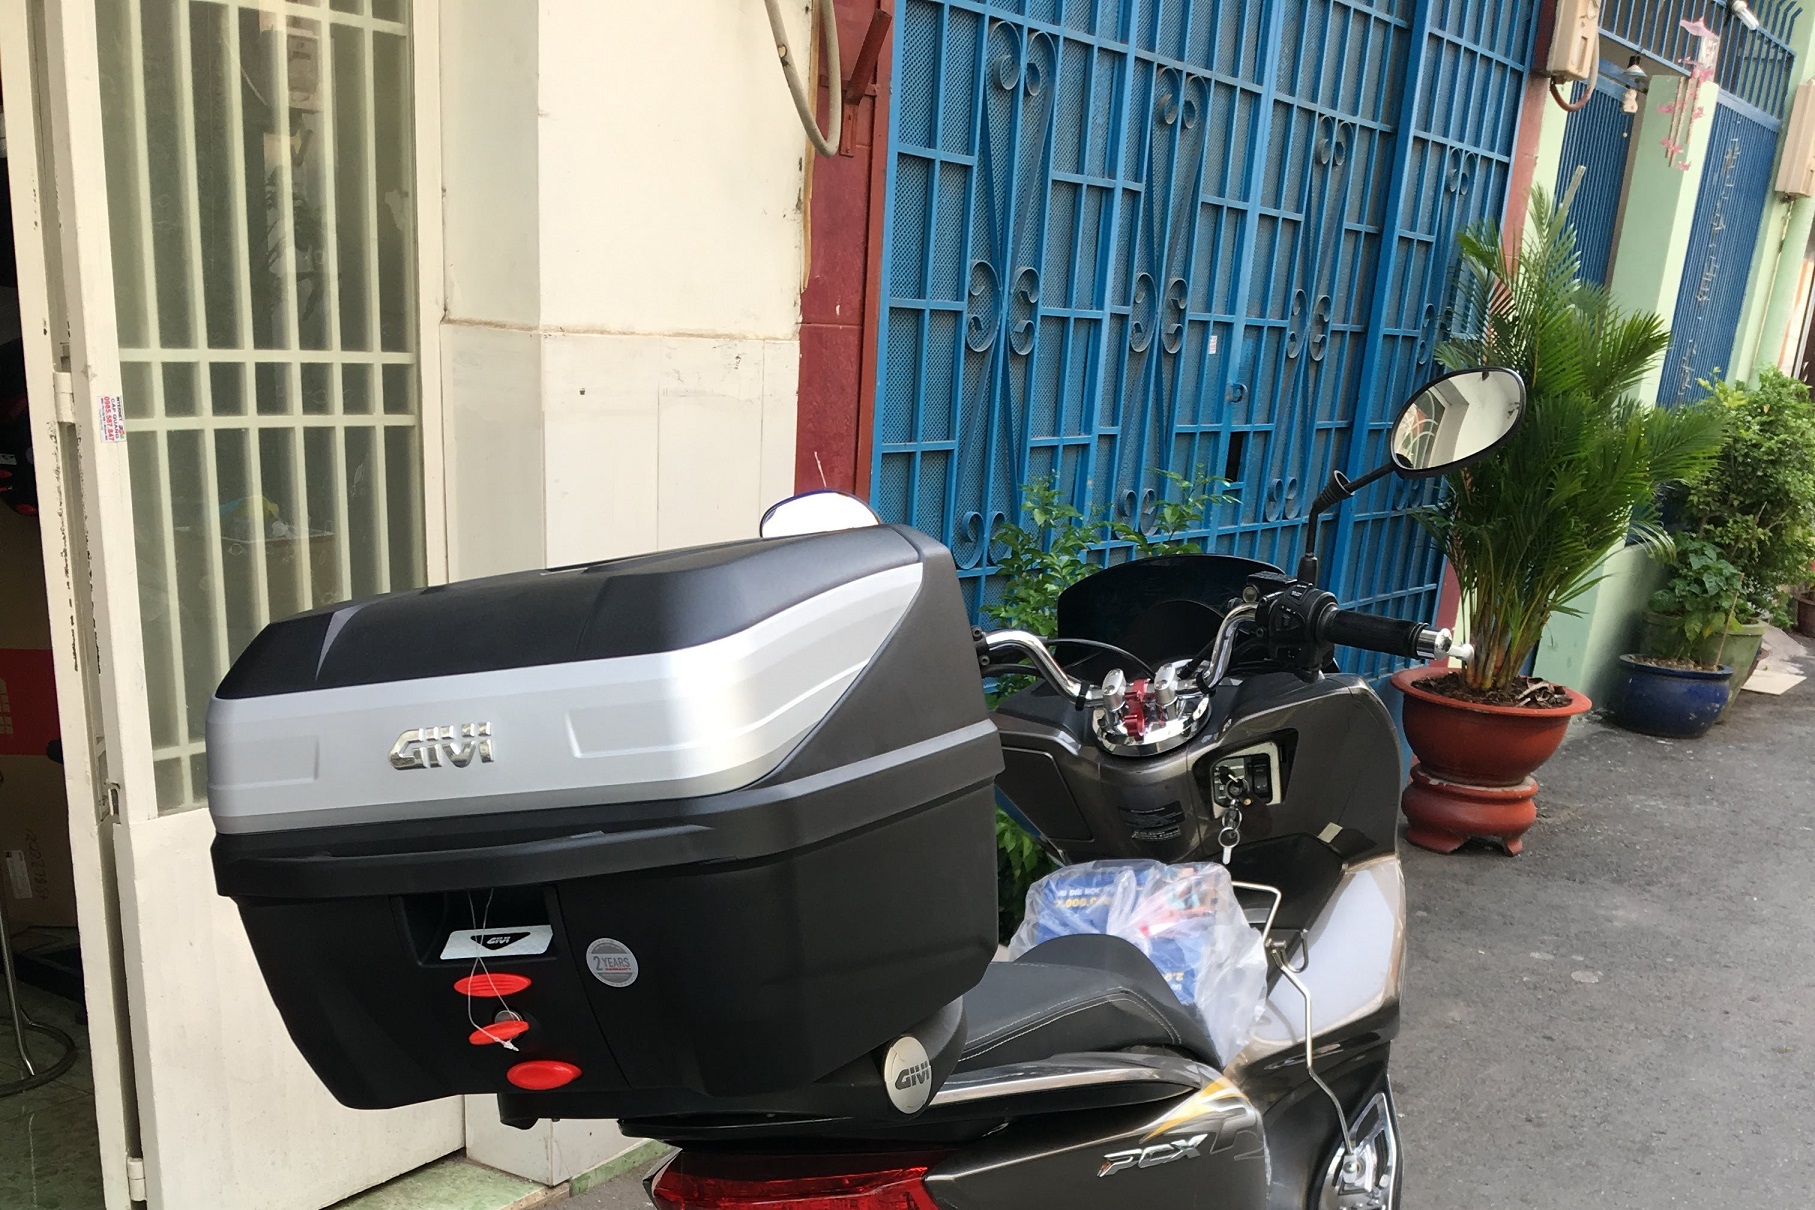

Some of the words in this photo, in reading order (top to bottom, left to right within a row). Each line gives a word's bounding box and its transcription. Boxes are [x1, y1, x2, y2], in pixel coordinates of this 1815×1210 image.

[389, 720, 494, 770] GIVI
[486, 936, 511, 945] GIVI
[593, 955, 603, 971] 2
[602, 957, 631, 968] YEARS
[895, 1060, 930, 1090] GIVI
[1097, 1133, 1208, 1177] PCX
